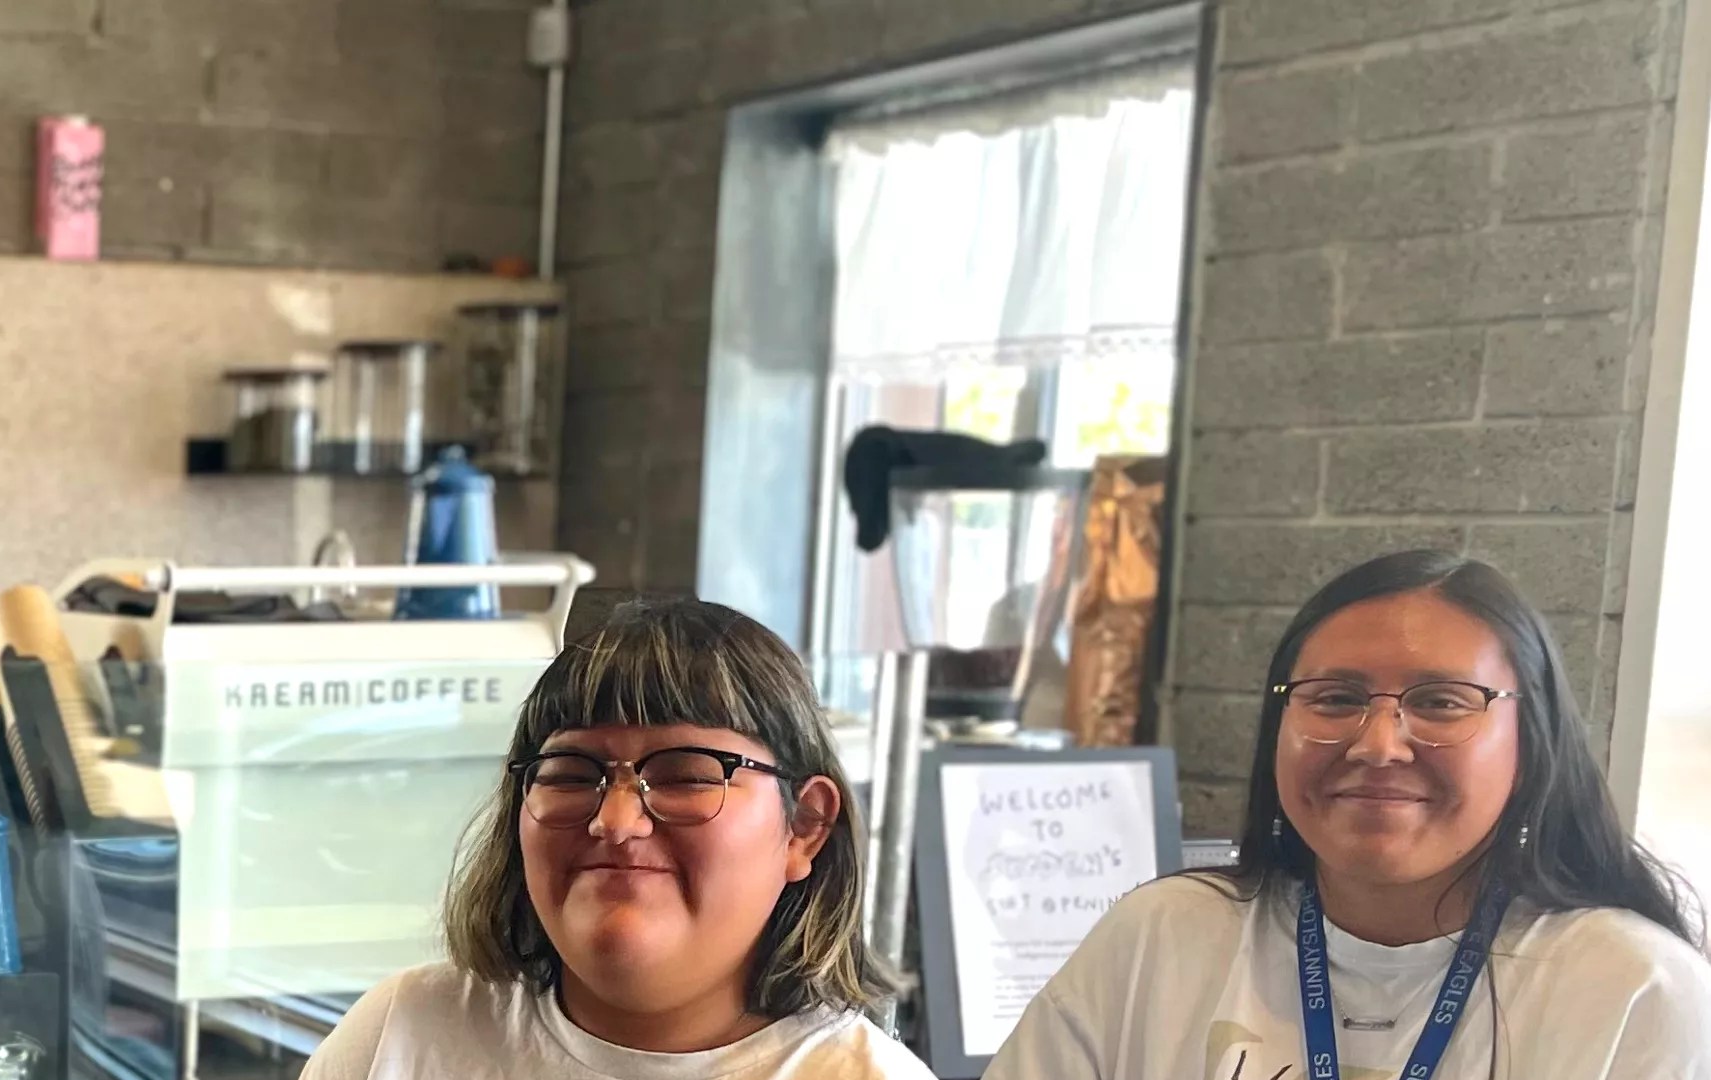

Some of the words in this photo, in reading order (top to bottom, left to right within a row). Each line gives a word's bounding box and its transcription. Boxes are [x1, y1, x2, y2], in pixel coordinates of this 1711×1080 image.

[368, 677, 502, 704] COFFEE
[979, 781, 1112, 817] WELCOME
[1030, 818, 1065, 842] TO
[1434, 949, 1481, 1025] EAGLES
